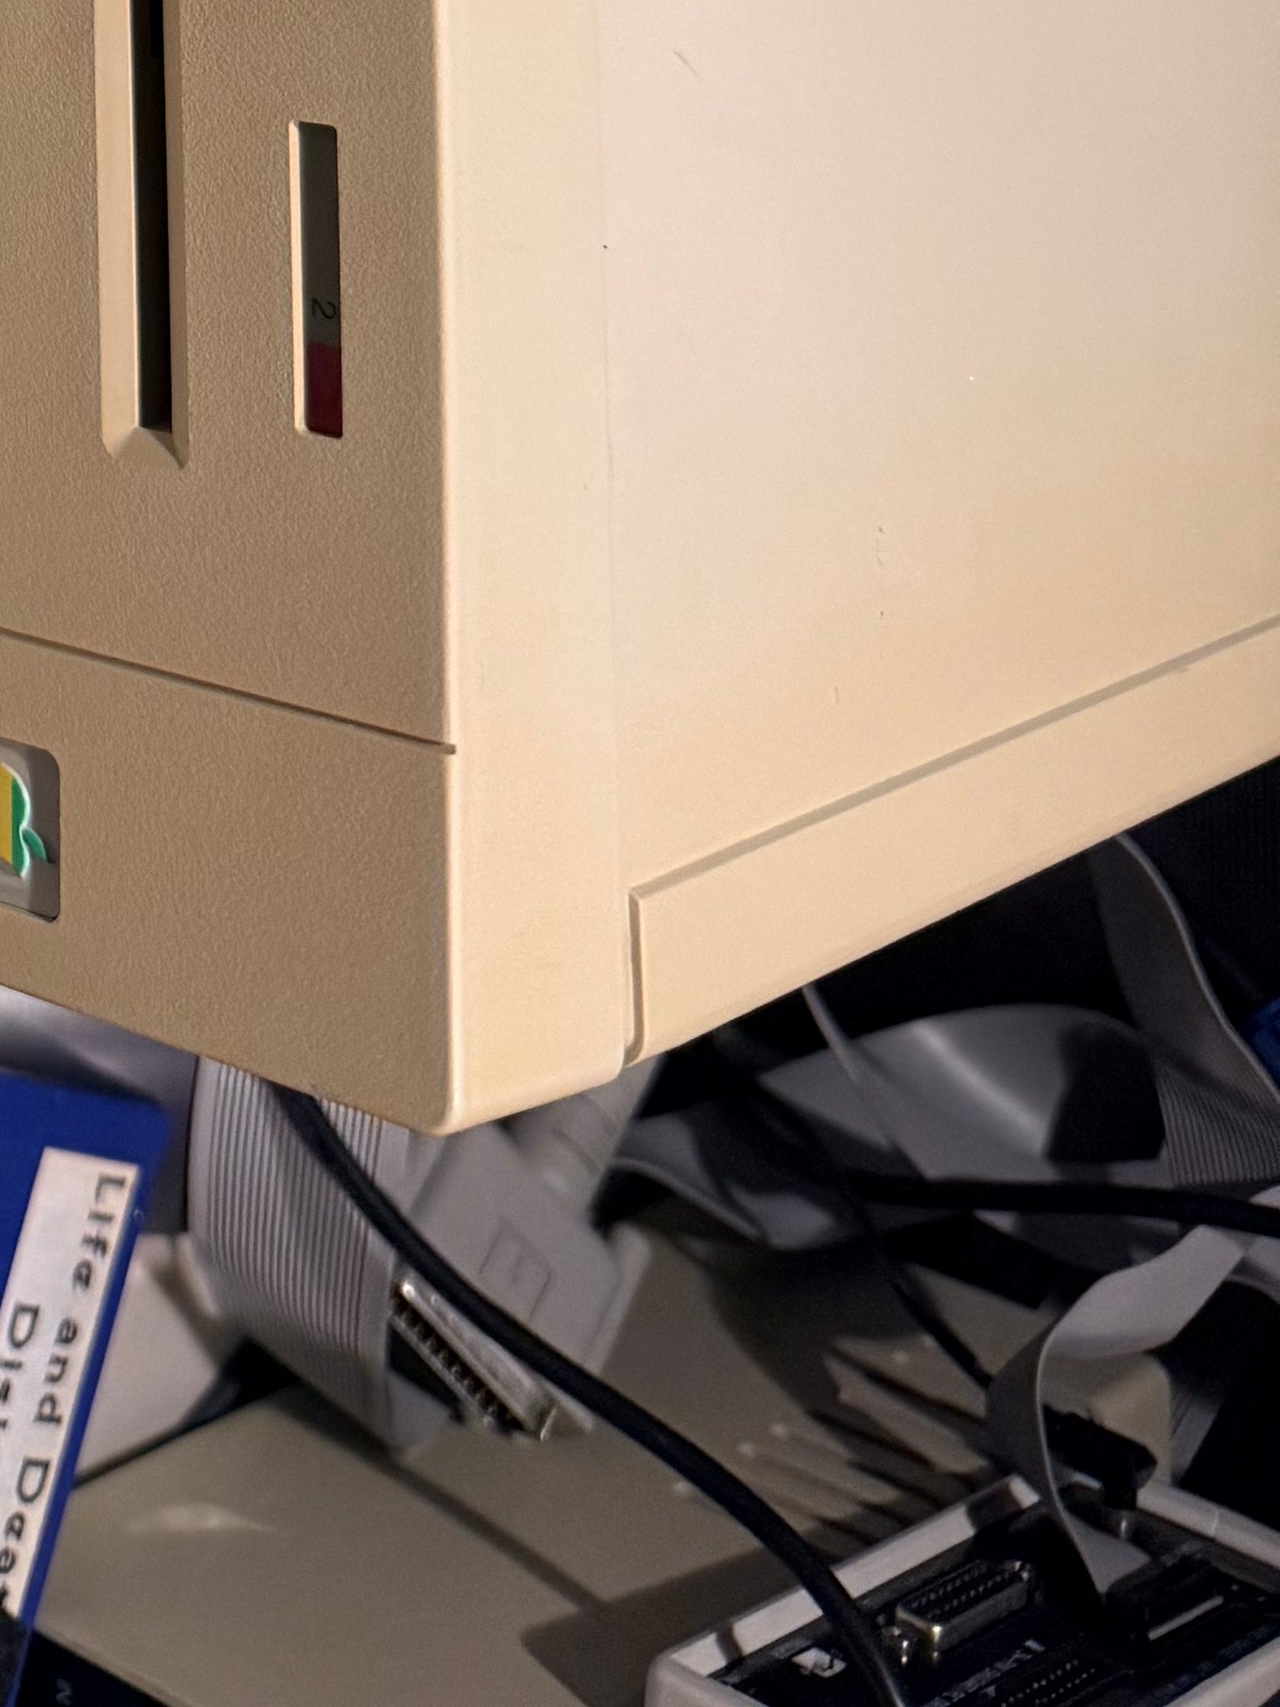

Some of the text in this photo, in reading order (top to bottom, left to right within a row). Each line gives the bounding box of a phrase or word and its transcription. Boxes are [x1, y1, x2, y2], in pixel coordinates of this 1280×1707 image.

[311, 297, 336, 320] 2
[72, 1172, 126, 1290] Life
[33, 1318, 80, 1425] and
